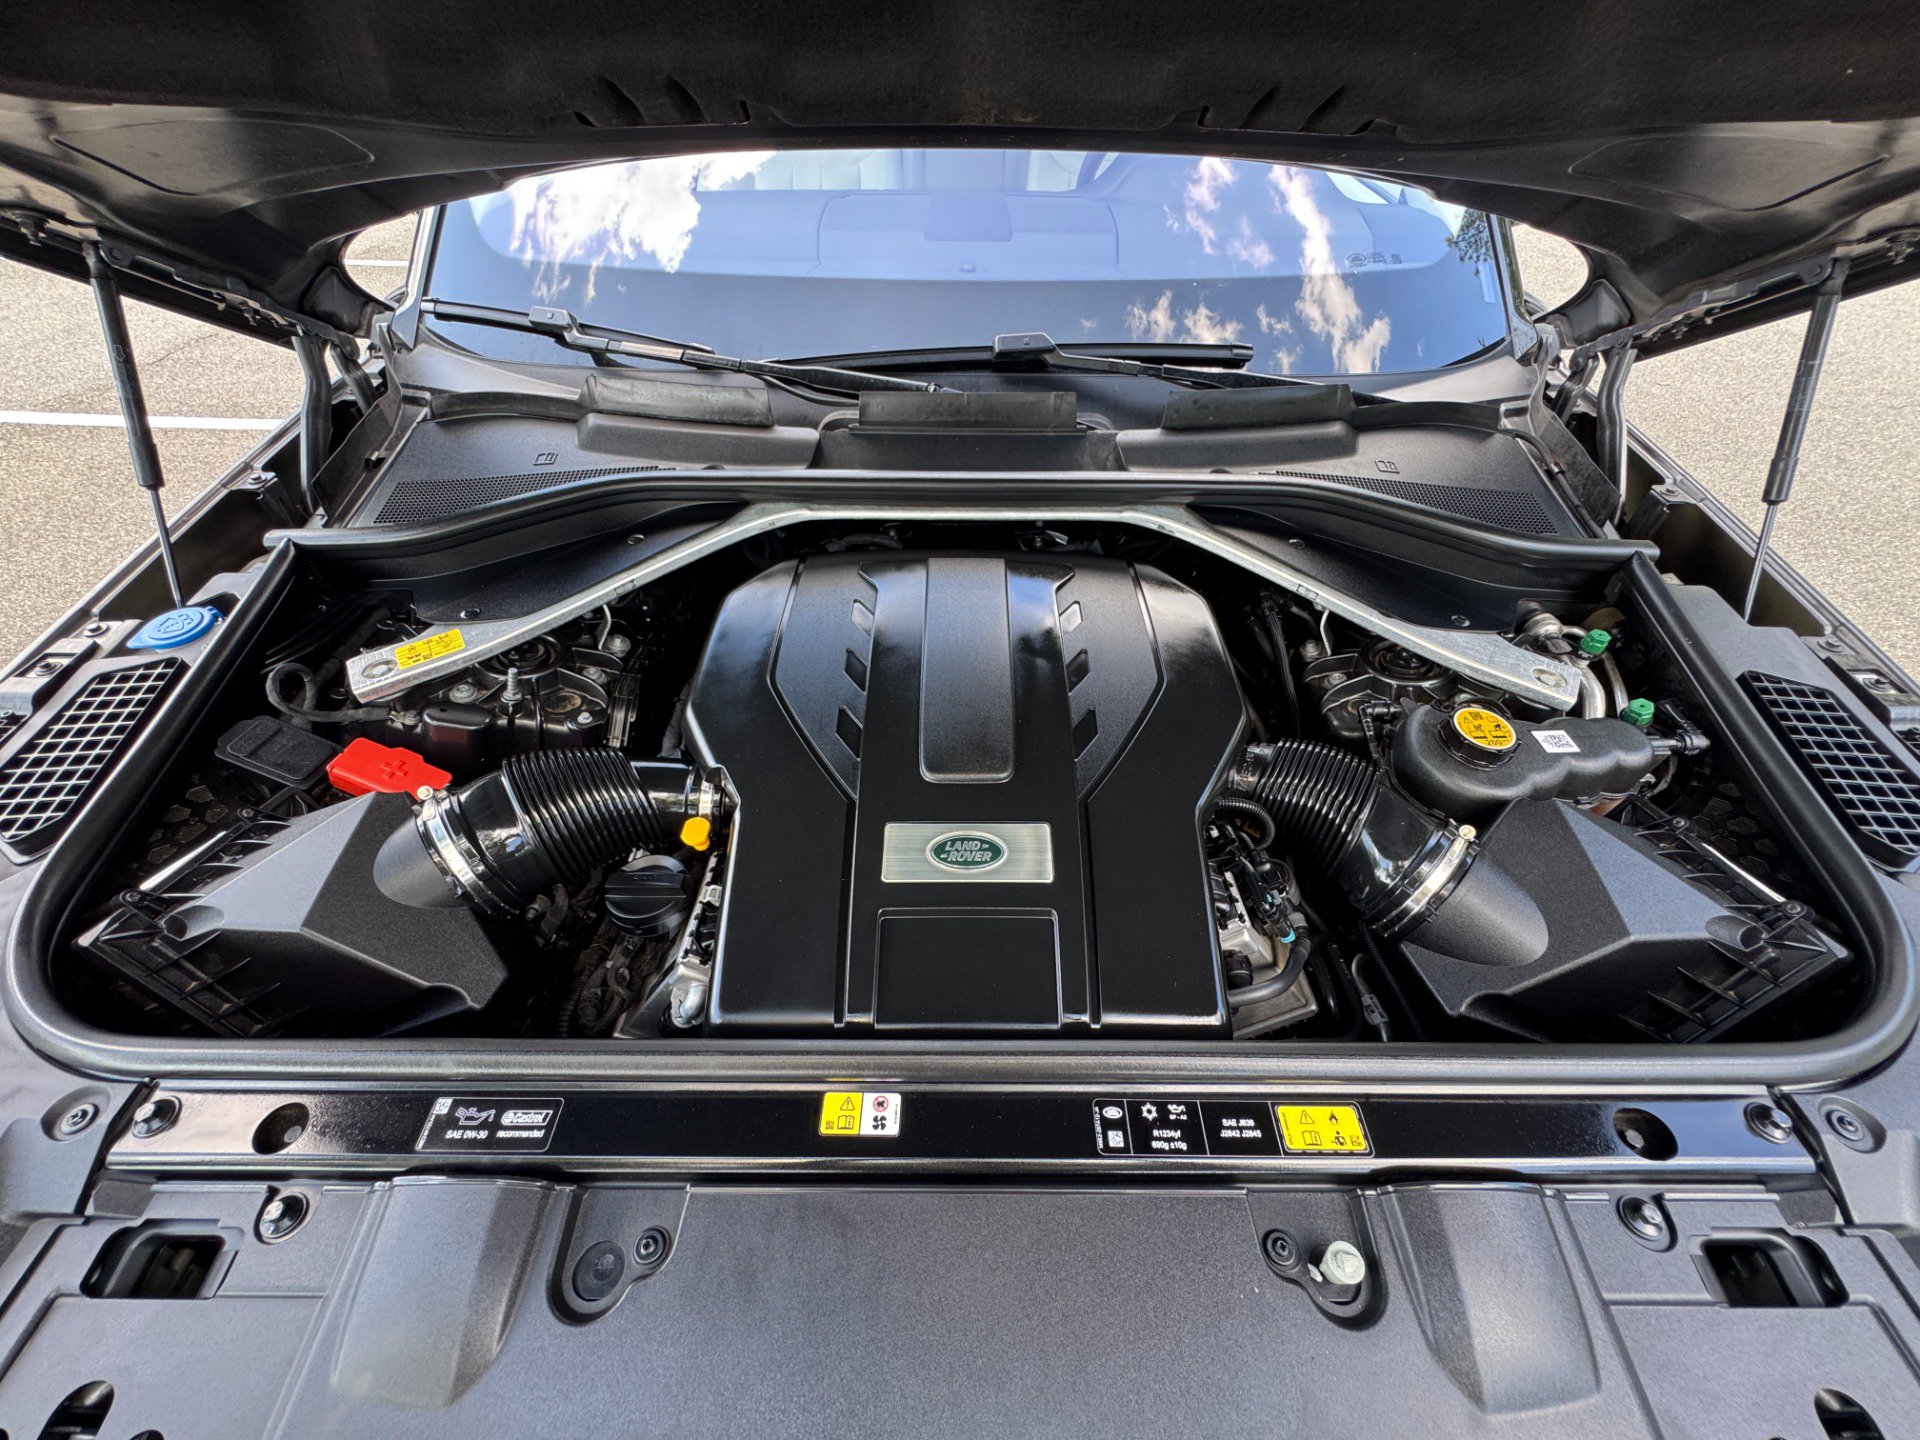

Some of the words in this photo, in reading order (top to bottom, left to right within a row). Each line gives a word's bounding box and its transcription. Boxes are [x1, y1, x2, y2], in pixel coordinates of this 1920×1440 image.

[945, 841, 981, 851] LAND
[948, 851, 992, 861] ROVER
[514, 1112, 544, 1123] Castrol
[1222, 1118, 1237, 1127] SAE
[1239, 1118, 1255, 1127] J639
[446, 1129, 462, 1139] SAE
[463, 1129, 489, 1139] 0W-30
[496, 1128, 545, 1138] recommended
[1153, 1129, 1181, 1139] R1234yf
